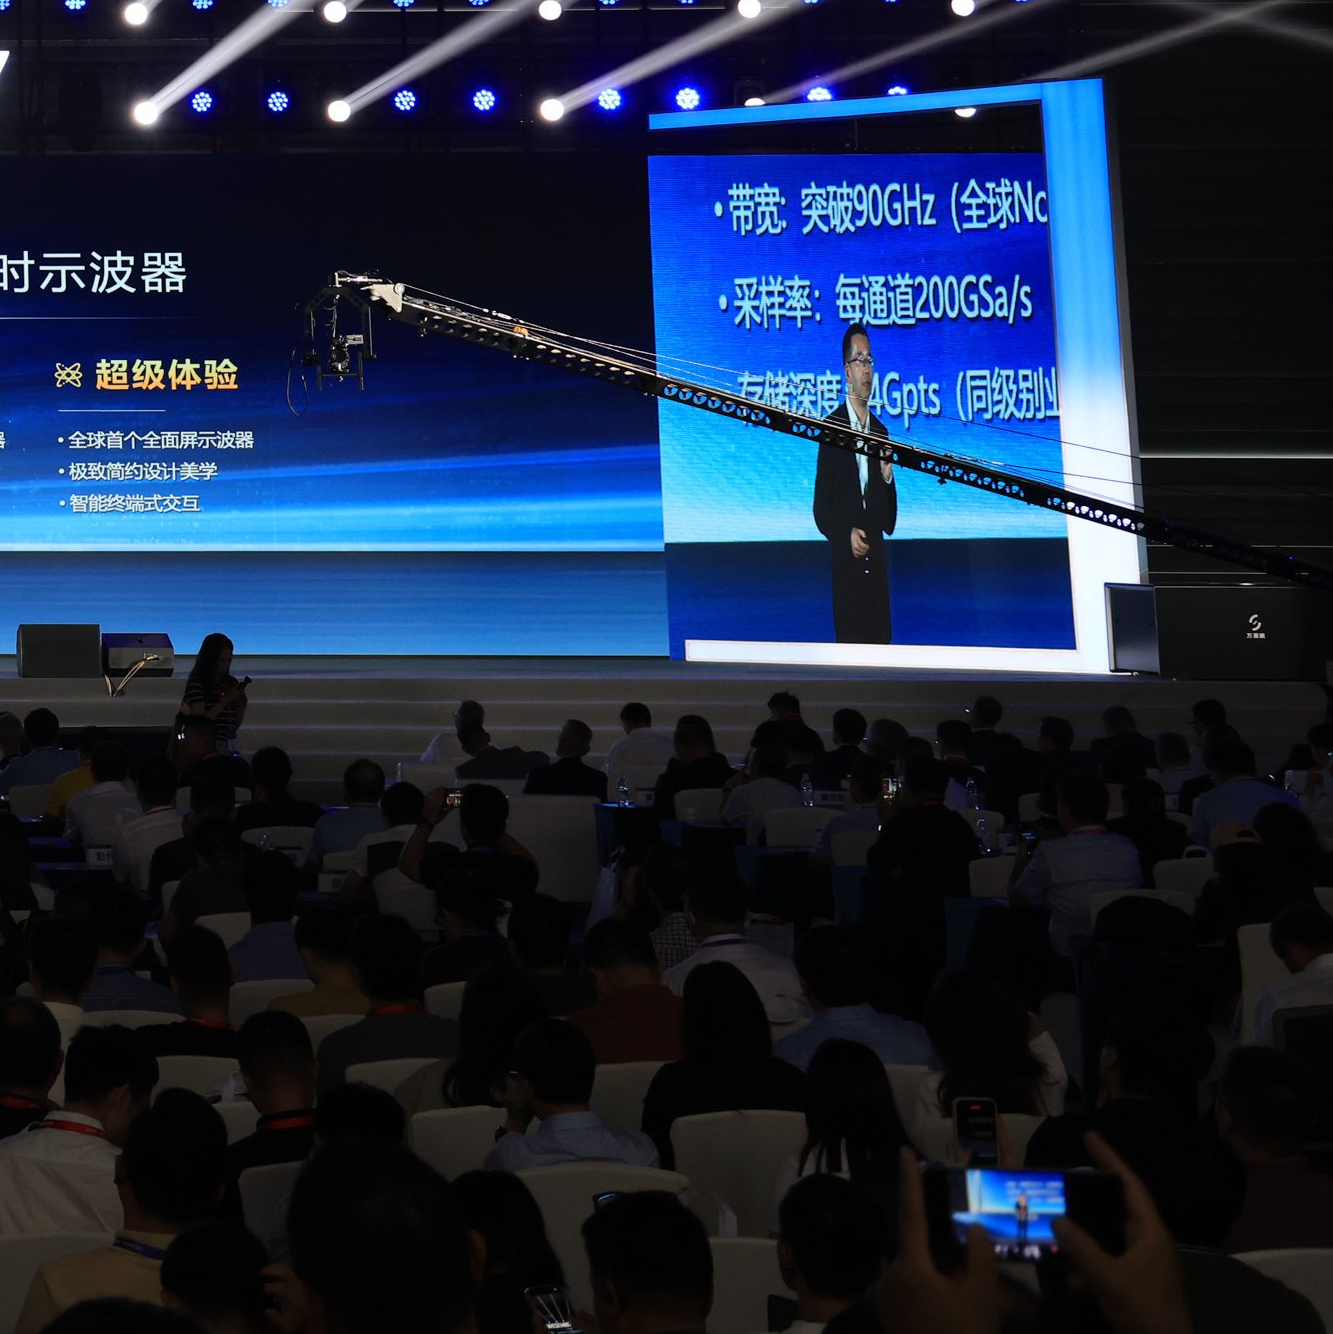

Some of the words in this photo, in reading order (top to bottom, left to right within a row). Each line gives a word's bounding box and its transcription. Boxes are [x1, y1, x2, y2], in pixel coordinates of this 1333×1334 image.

[95, 358, 239, 392] 超级体验
[68, 430, 254, 451] 全球首个全面屏示波器
[68, 462, 218, 482] 极致简约设计美学
[69, 494, 201, 514] 智能终端式交互
